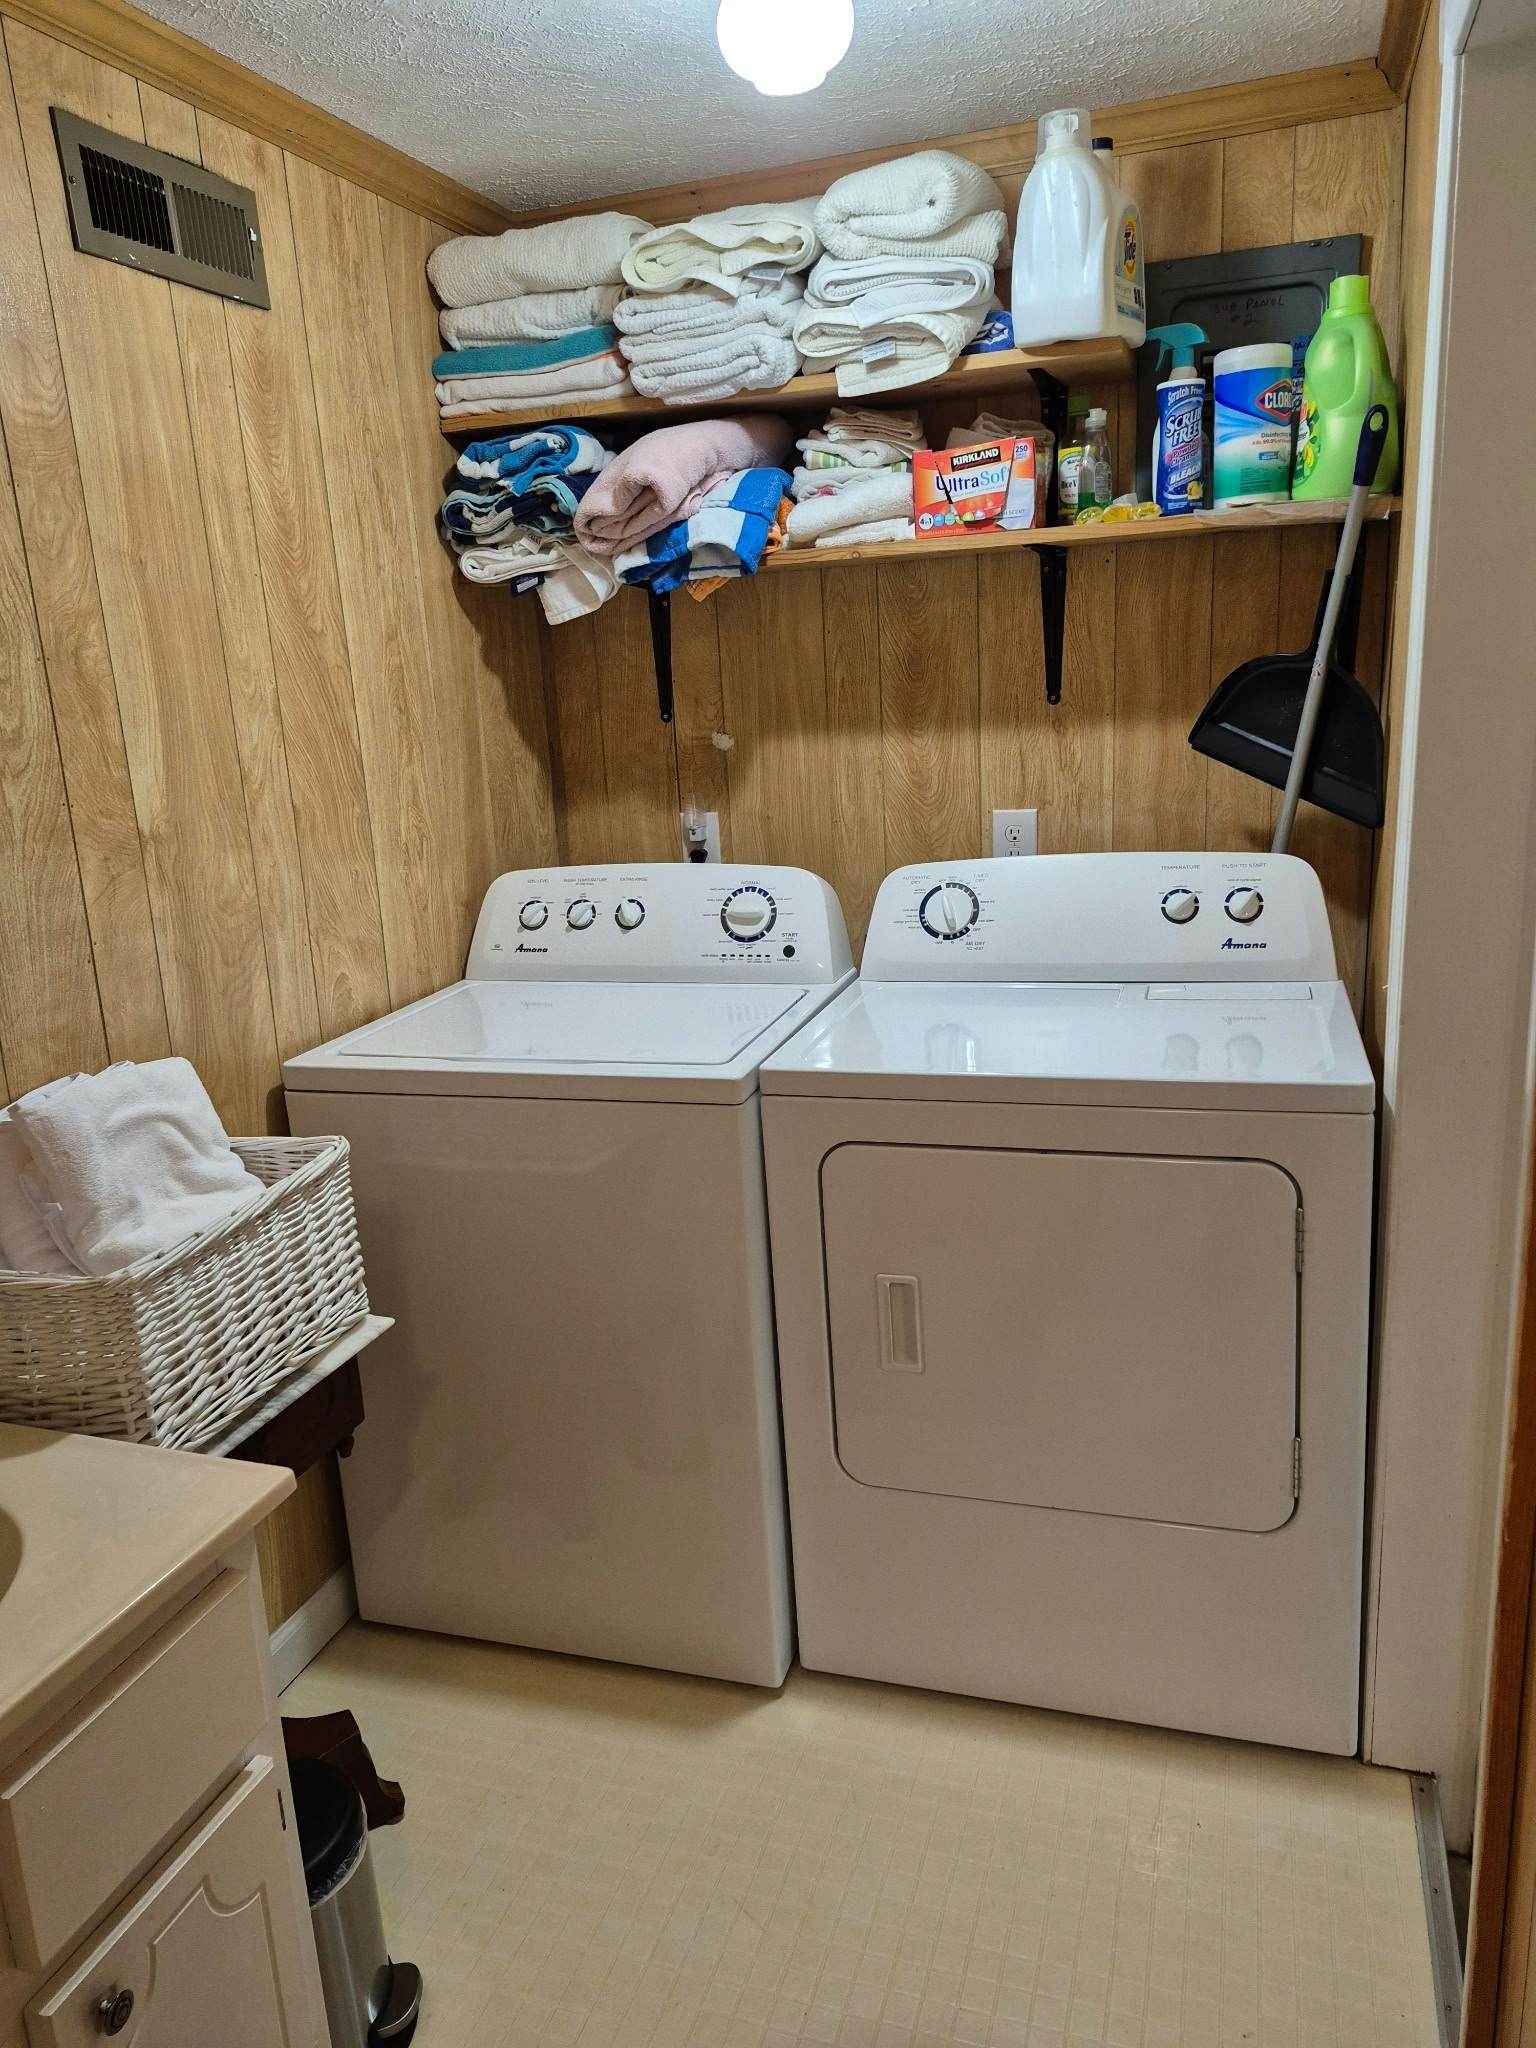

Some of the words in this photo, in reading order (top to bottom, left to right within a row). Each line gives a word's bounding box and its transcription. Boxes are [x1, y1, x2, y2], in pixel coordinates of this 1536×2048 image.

[1172, 421, 1202, 447] FREE
[1016, 444, 1028, 453] 250
[953, 448, 999, 466] KIRKLAND
[514, 943, 549, 953] Amana
[1220, 937, 1268, 950] Amana
